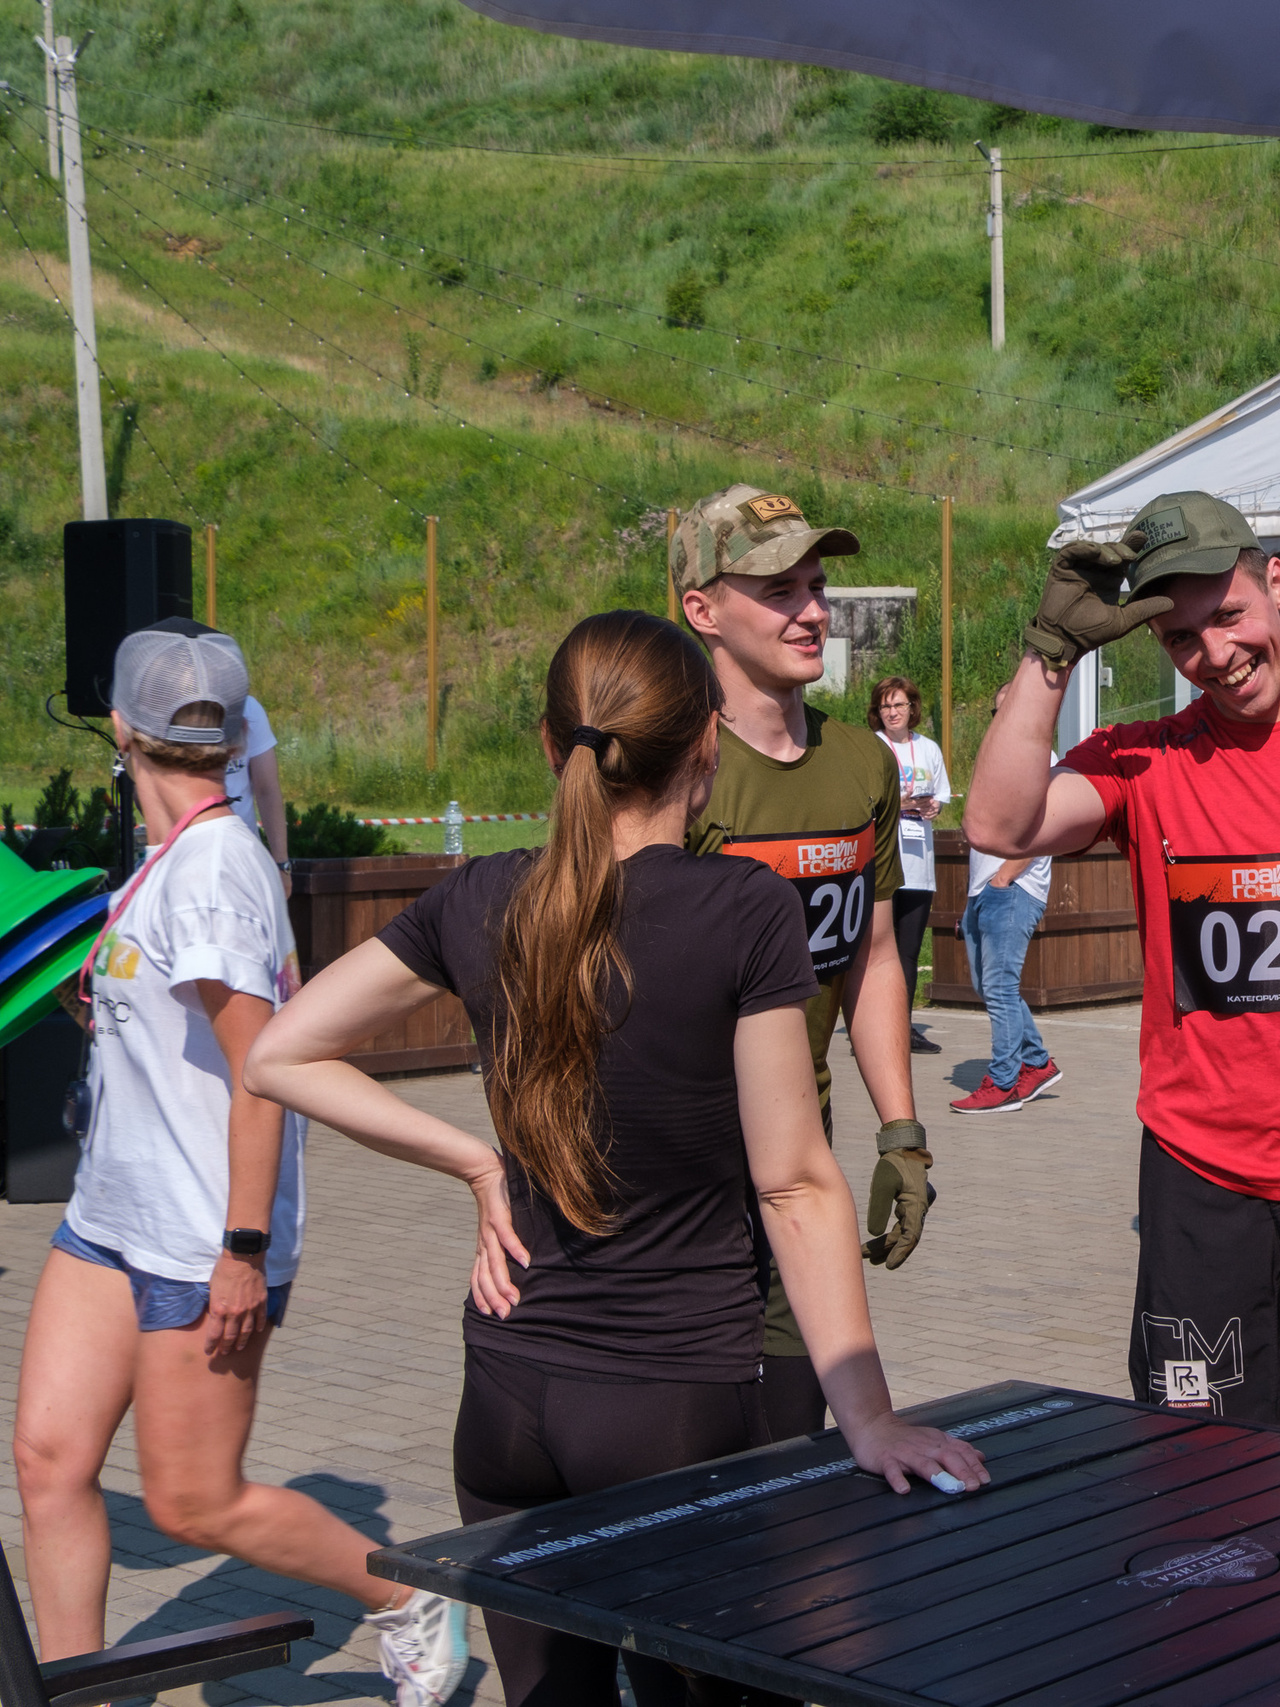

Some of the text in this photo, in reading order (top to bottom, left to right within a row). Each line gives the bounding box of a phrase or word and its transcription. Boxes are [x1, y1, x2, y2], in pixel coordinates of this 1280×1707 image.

[1149, 529, 1167, 541] ARA
[808, 874, 865, 953] 20
[588, 1504, 702, 1538] АЛКОГОЛЬНОЙ
[491, 1534, 598, 1566] ПРОДУКЦИИ
